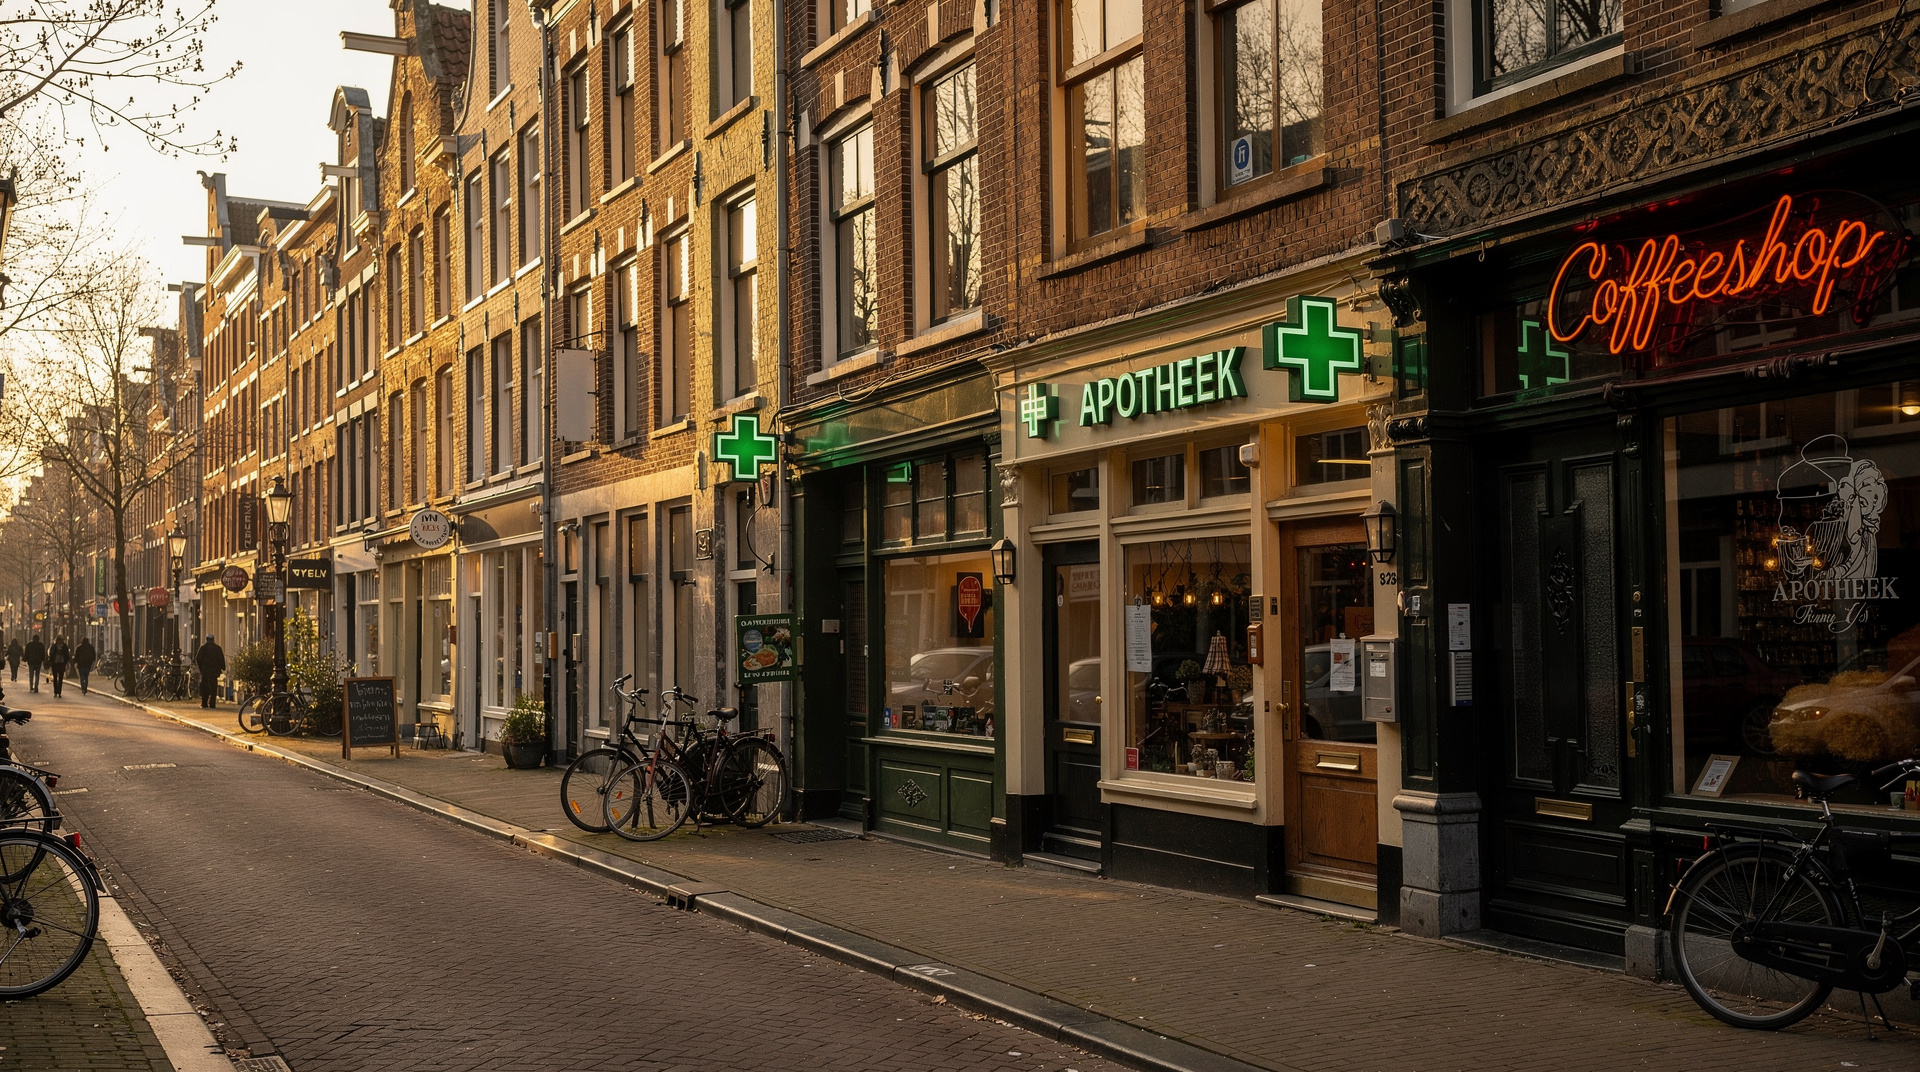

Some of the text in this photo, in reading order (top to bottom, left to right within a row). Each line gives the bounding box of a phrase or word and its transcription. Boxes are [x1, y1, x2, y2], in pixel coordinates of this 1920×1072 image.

[1548, 195, 1885, 355] Coffeeshop
[1079, 346, 1244, 427] APOTHEEK
[1772, 576, 1900, 602] APOTHEEK
